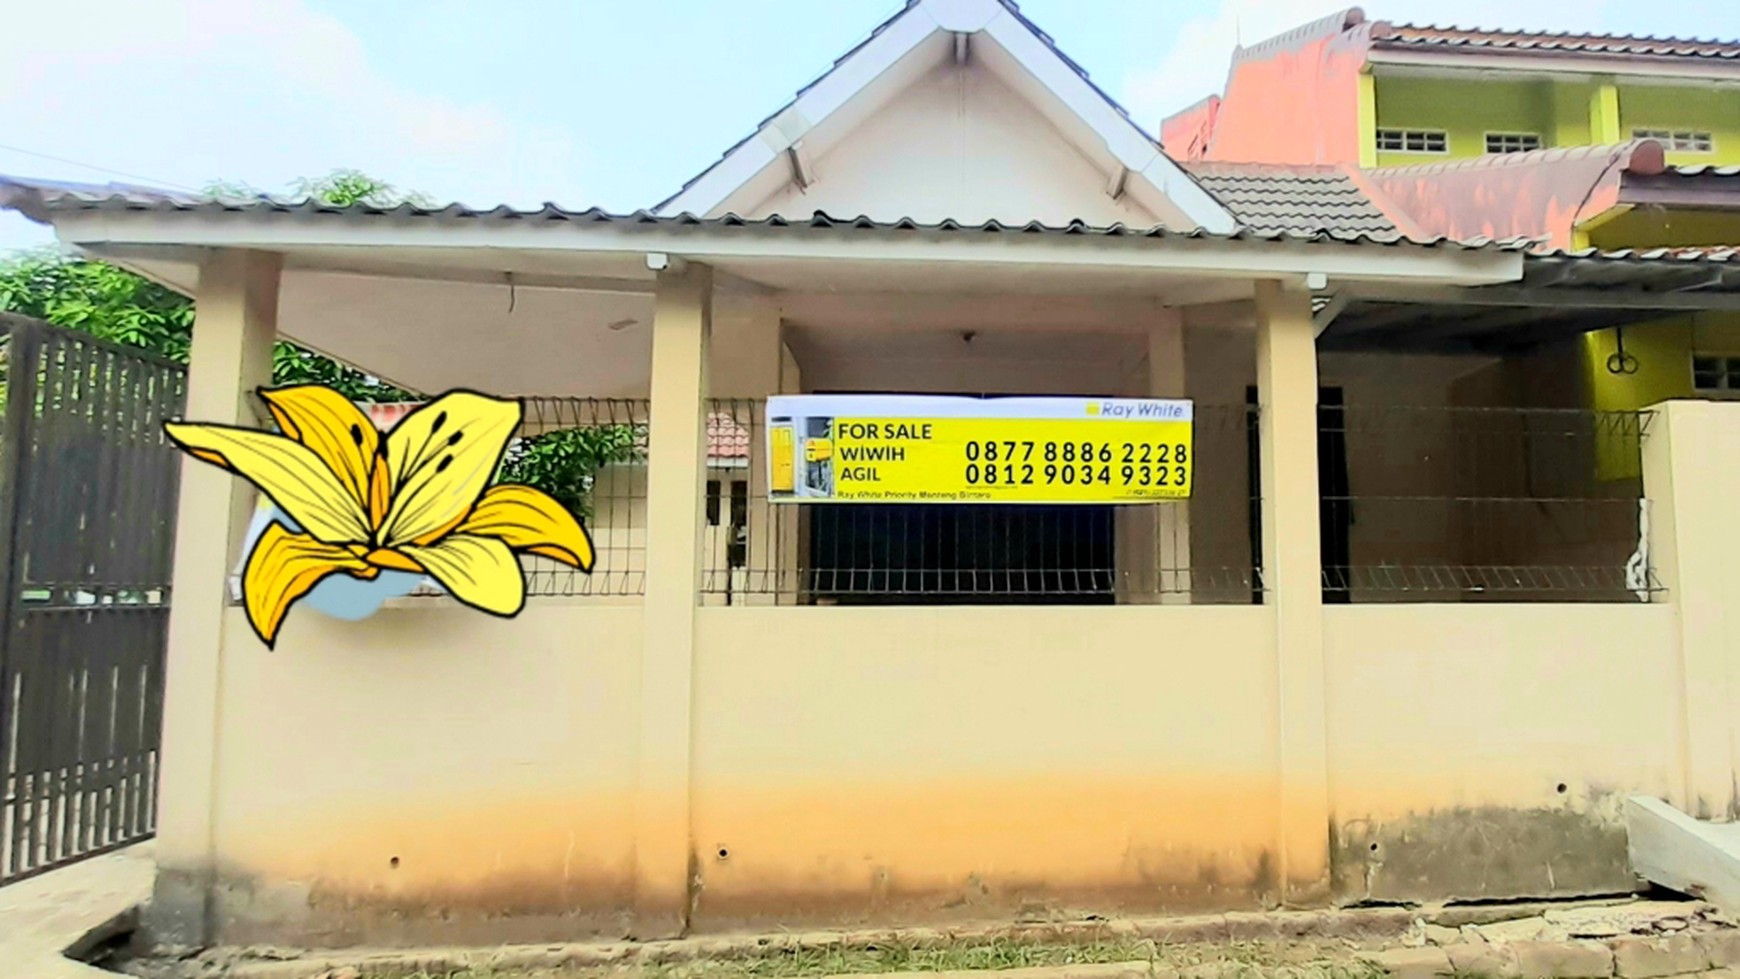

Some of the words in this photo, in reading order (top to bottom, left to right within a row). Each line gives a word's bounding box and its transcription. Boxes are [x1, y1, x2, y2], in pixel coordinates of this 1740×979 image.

[1102, 402, 1134, 418] Ray
[1138, 403, 1183, 417] White
[838, 423, 879, 439] FOR
[884, 423, 932, 439] SALE
[965, 440, 1035, 461] 0877
[1044, 441, 1112, 463] 8886
[1121, 443, 1187, 464] 2228
[840, 467, 881, 481] AGIL
[965, 463, 1034, 484] 0812
[1044, 464, 1111, 485] 9034
[1121, 465, 1186, 486] 9323
[884, 490, 917, 499] Priority
